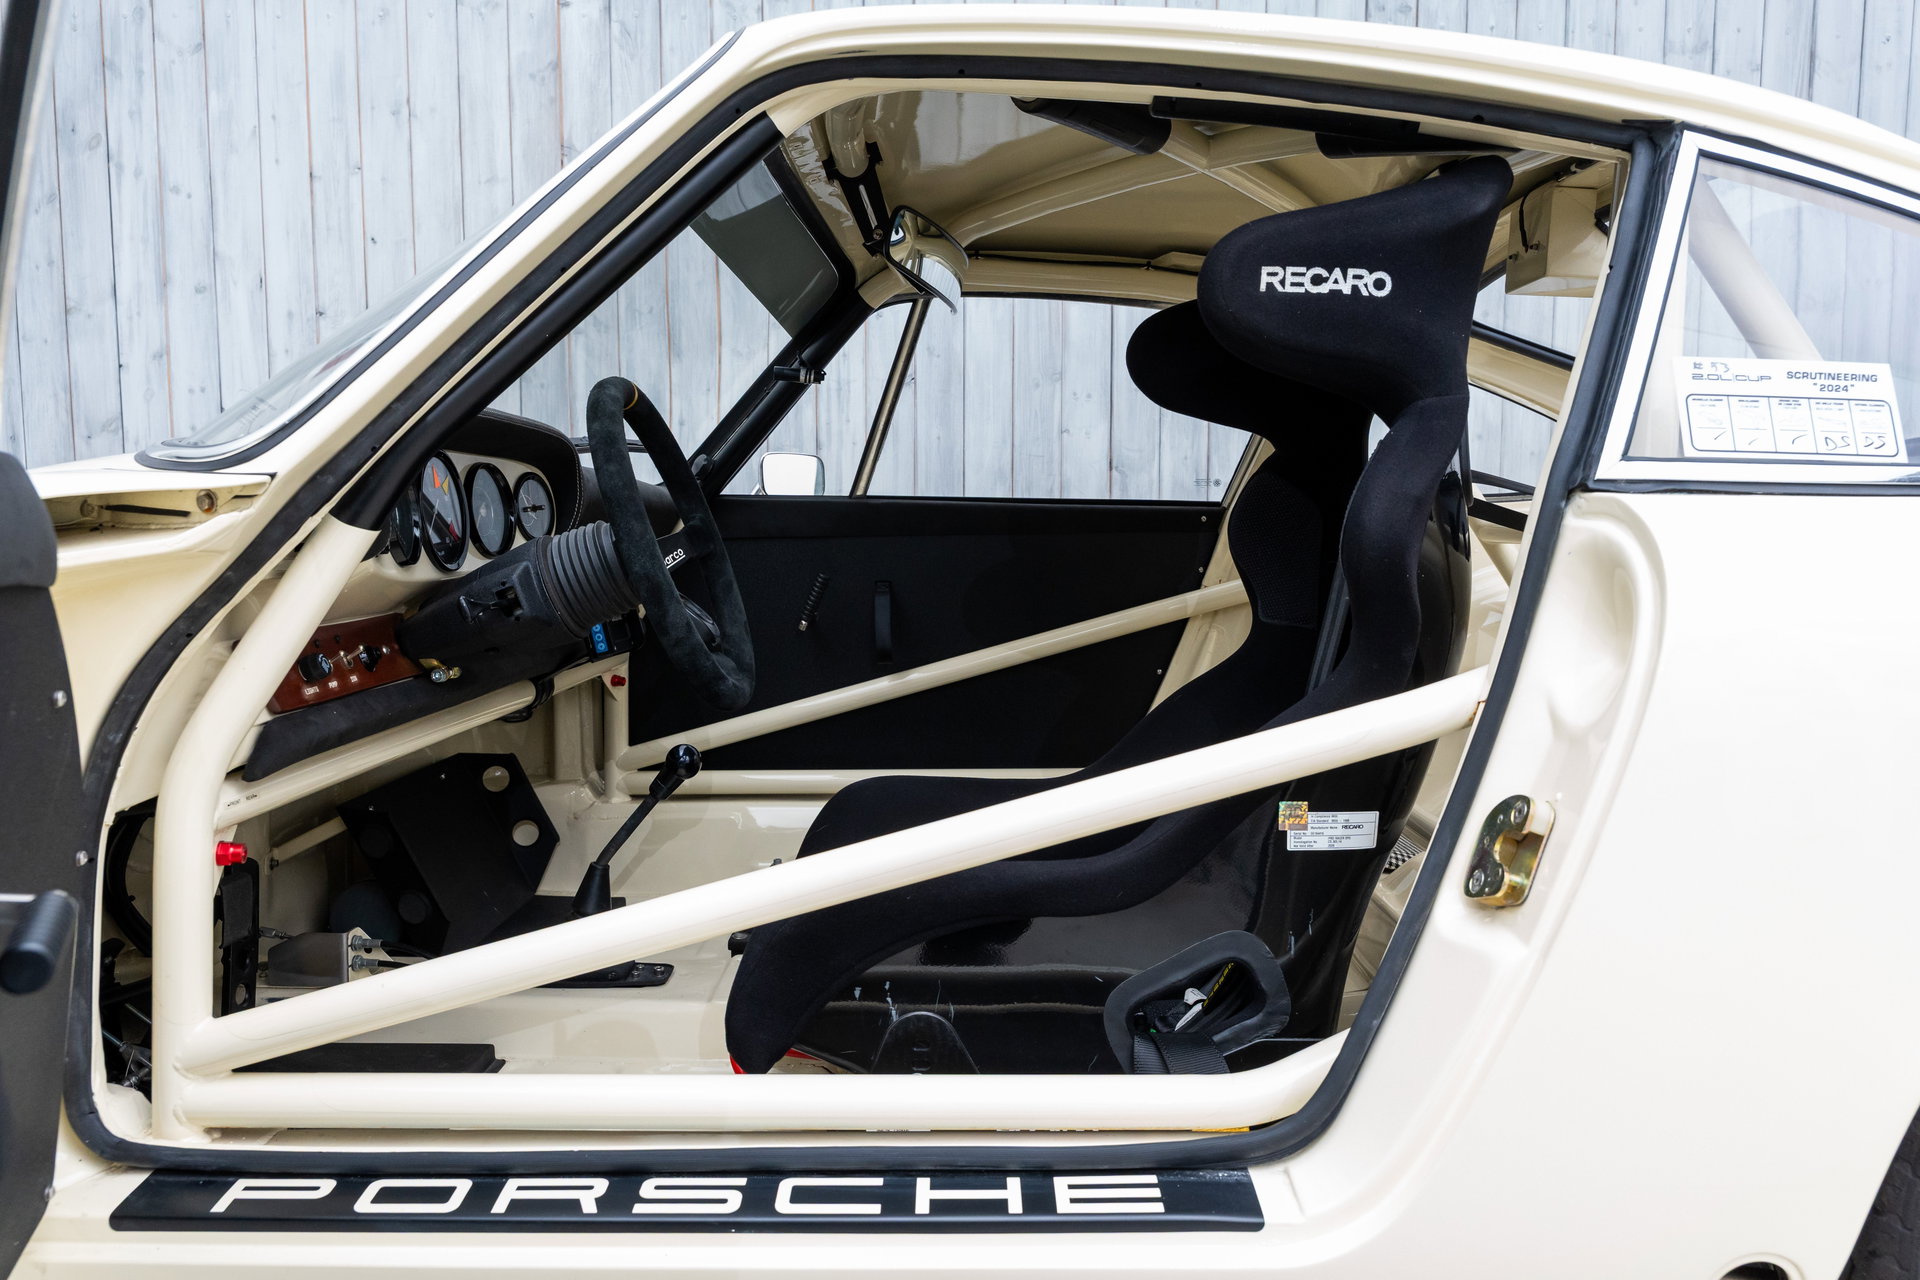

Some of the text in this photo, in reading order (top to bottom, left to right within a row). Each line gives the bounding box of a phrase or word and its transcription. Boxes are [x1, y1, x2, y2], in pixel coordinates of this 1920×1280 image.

[1259, 265, 1393, 298] RECARO
[1786, 371, 1878, 383] SCRUTINEERING
[663, 548, 684, 566] arco
[209, 1174, 1166, 1214] PORSCHE
